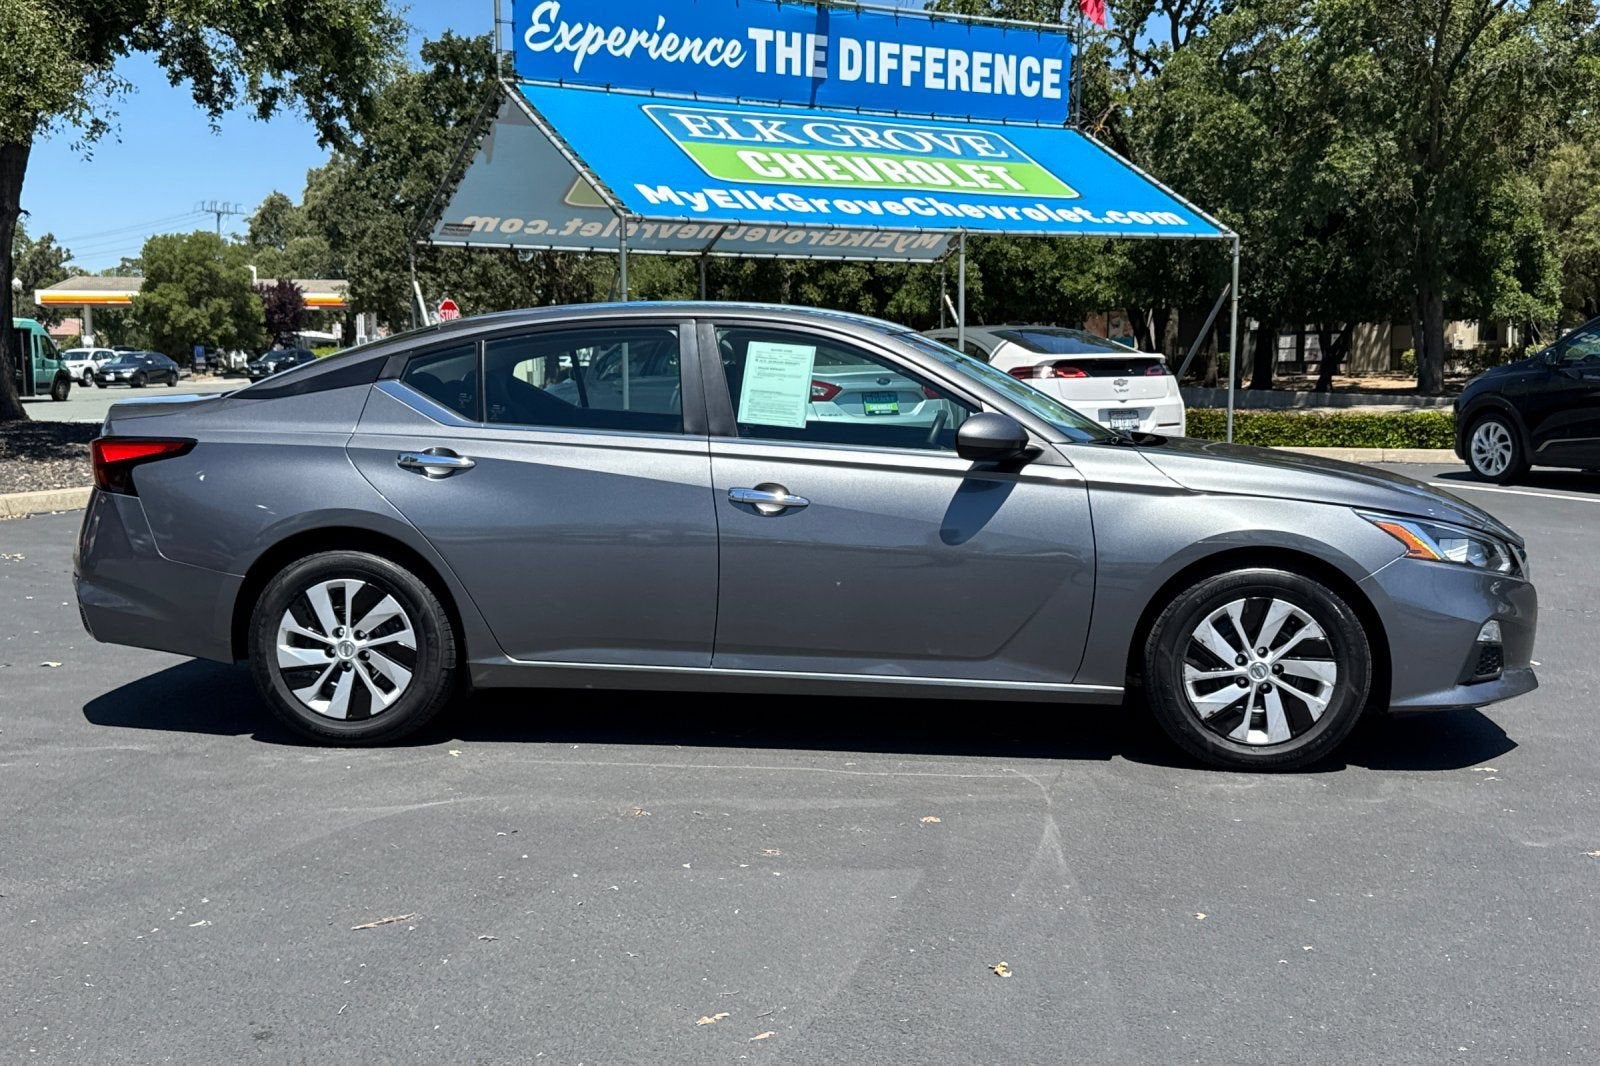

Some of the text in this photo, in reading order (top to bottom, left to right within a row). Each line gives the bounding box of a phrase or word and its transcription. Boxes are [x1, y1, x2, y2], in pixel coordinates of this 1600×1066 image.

[524, 0, 1063, 100] Experience THE DIFFERENCE
[669, 112, 1010, 160] ELK GROVE
[735, 150, 1027, 192] CHEVROLET
[633, 183, 1189, 227] MyElkGroveChevrolet.com
[439, 309, 460, 321] STOP
